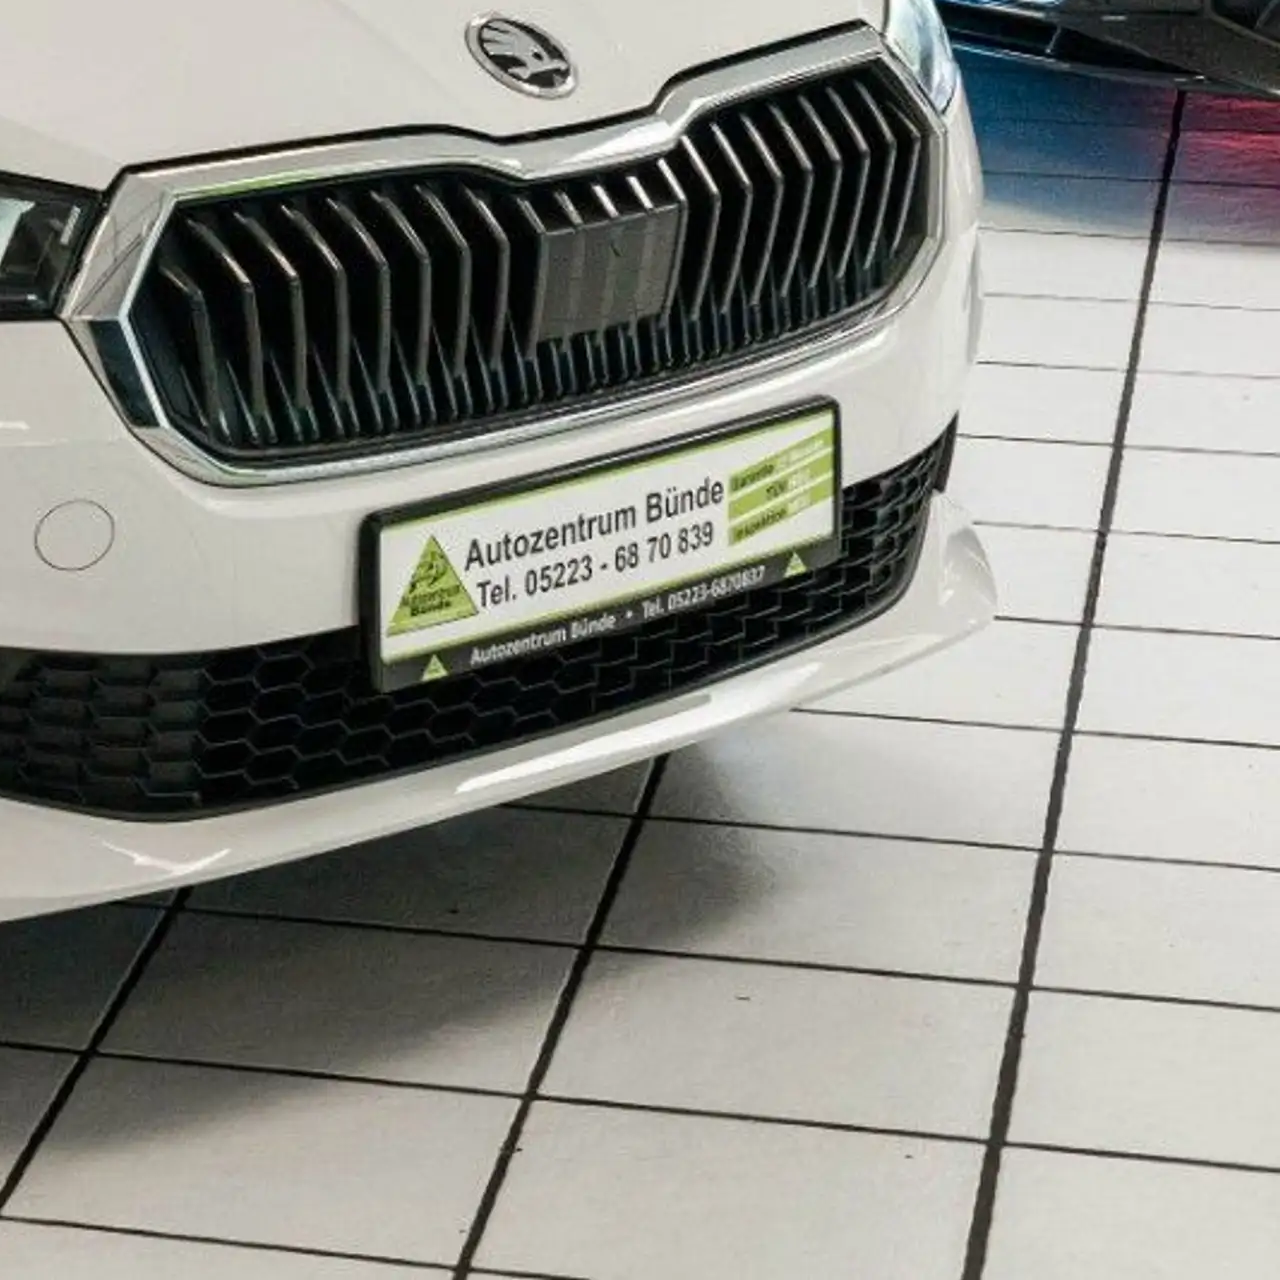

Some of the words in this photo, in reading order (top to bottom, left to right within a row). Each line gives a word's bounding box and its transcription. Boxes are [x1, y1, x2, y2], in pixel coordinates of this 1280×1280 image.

[464, 505, 637, 571] Autozentrum
[646, 476, 725, 523] Bünde
[477, 573, 518, 608] Tel.
[525, 555, 593, 597] 05223
[614, 542, 639, 573] 68
[646, 533, 672, 563] 70
[677, 521, 714, 554] 839
[470, 627, 567, 666] Autozentrum
[571, 613, 618, 639] Bünde
[642, 595, 665, 619] Tel.
